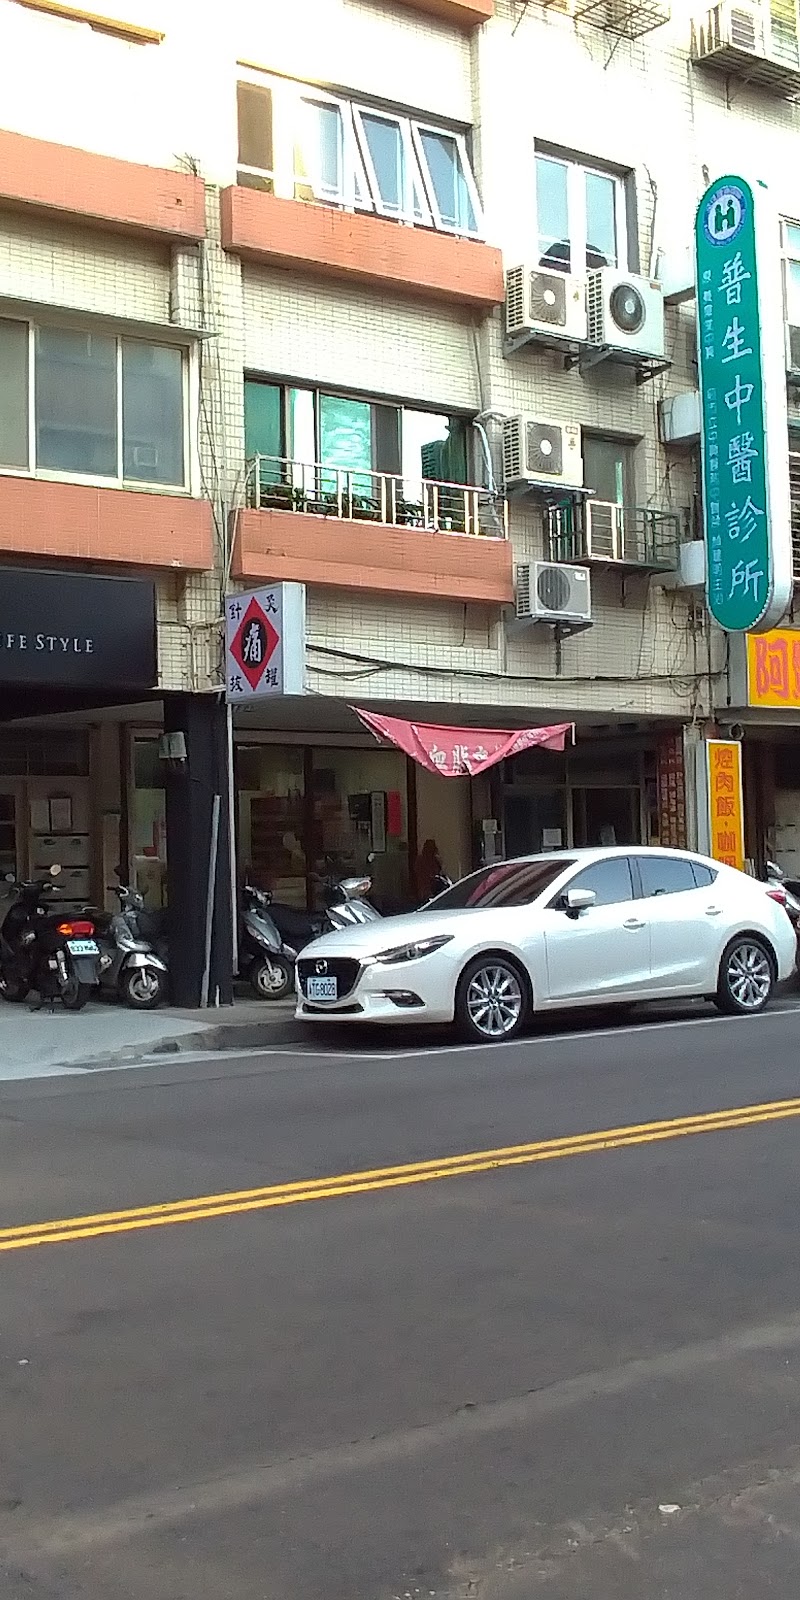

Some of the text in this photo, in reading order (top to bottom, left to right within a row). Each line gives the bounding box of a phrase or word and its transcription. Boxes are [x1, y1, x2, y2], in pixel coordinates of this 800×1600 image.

[0, 633, 94, 653] FE STYLE
[243, 622, 262, 663] 痛
